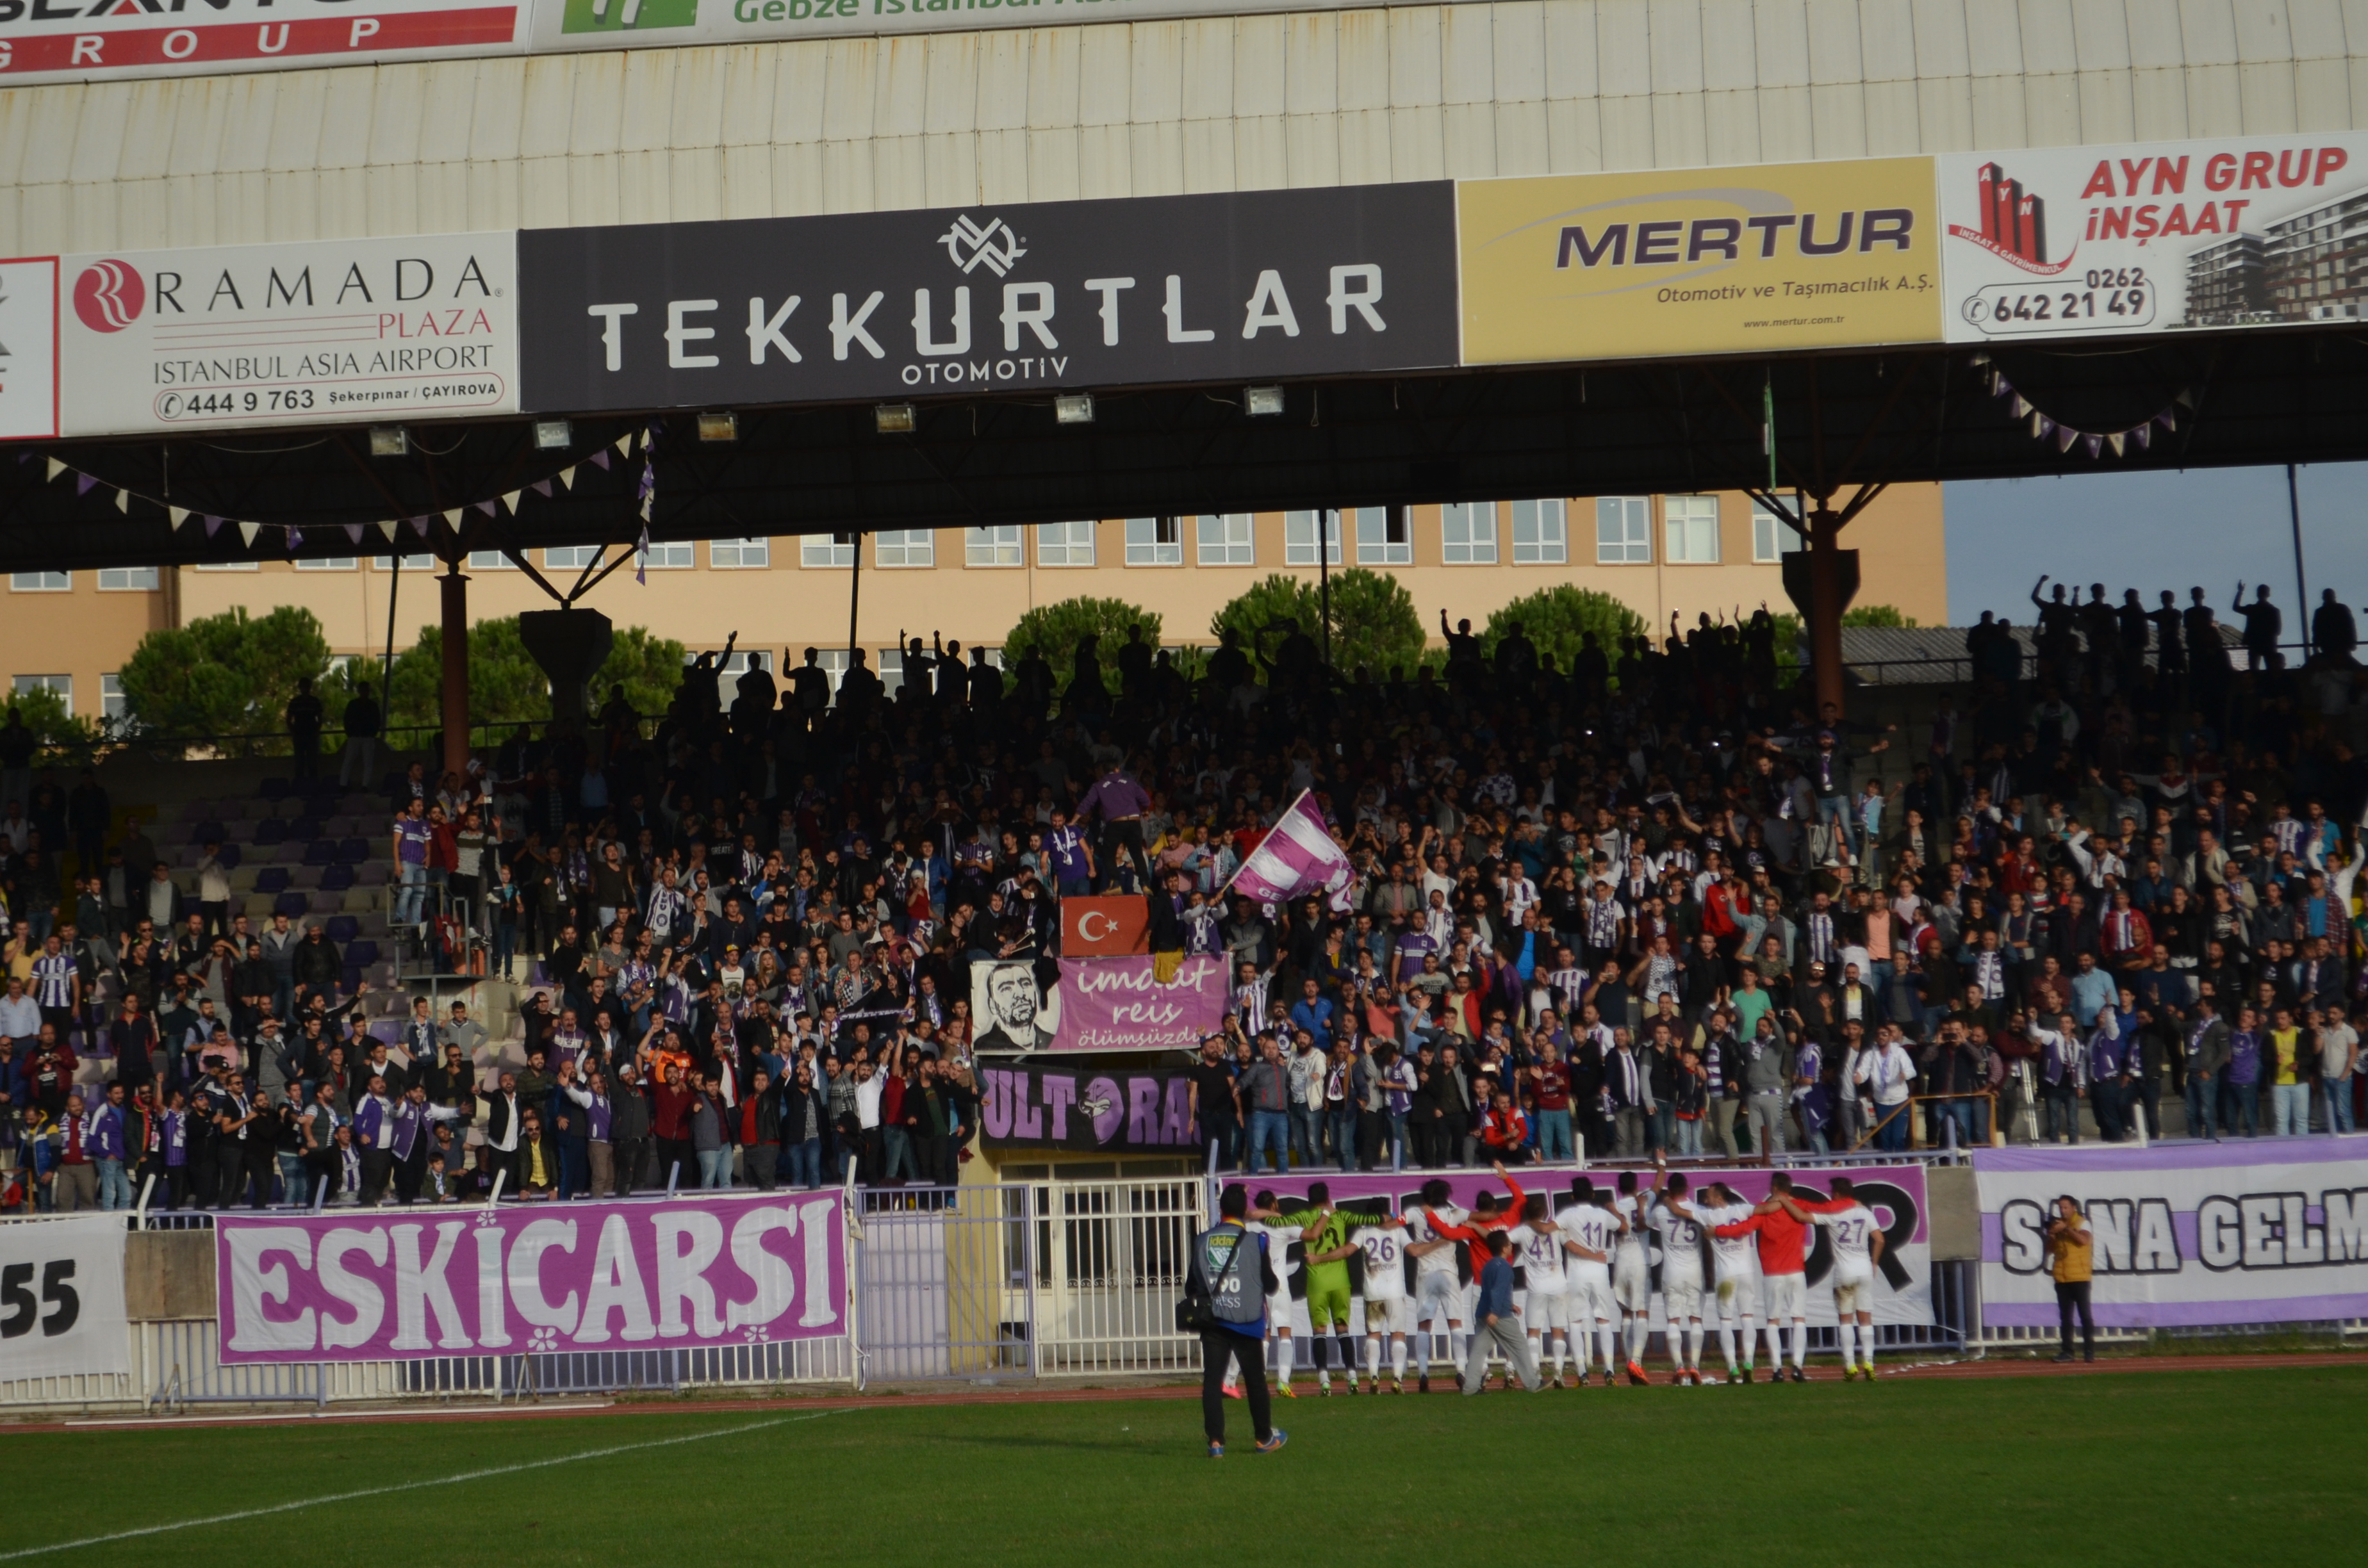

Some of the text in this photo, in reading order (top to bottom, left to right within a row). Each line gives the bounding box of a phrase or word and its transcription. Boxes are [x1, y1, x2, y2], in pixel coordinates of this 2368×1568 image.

[2081, 147, 2347, 199] AYN GRUP
[1556, 208, 1914, 270] MERTUR
[156, 256, 492, 314] RAMADA
[1657, 274, 1934, 303] Otomotiv ve Taşımacılık A.Ş.
[2086, 267, 2145, 289] 0262
[588, 263, 1387, 372] TEKKURTLAR
[1994, 289, 2146, 322] 642 21 49
[379, 308, 493, 339] PLAZA
[1744, 314, 1845, 329] www.mertur.com.tr
[154, 345, 493, 384] ISTANBUL ASIA AIRPORT
[187, 393, 234, 414] 444
[243, 392, 258, 411] 9
[268, 389, 315, 411] 763
[422, 383, 497, 399] ÇAYIROVA
[1113, 995, 1183, 1025] reis
[1583, 1221, 1602, 1248] 11
[1667, 1218, 1698, 1243] 75
[1837, 1219, 1865, 1243] 27
[2001, 1198, 2182, 1275] SNA
[1365, 1237, 1395, 1262] 26
[1529, 1234, 1556, 1261] 41
[1215, 1295, 1241, 1309] RESS
